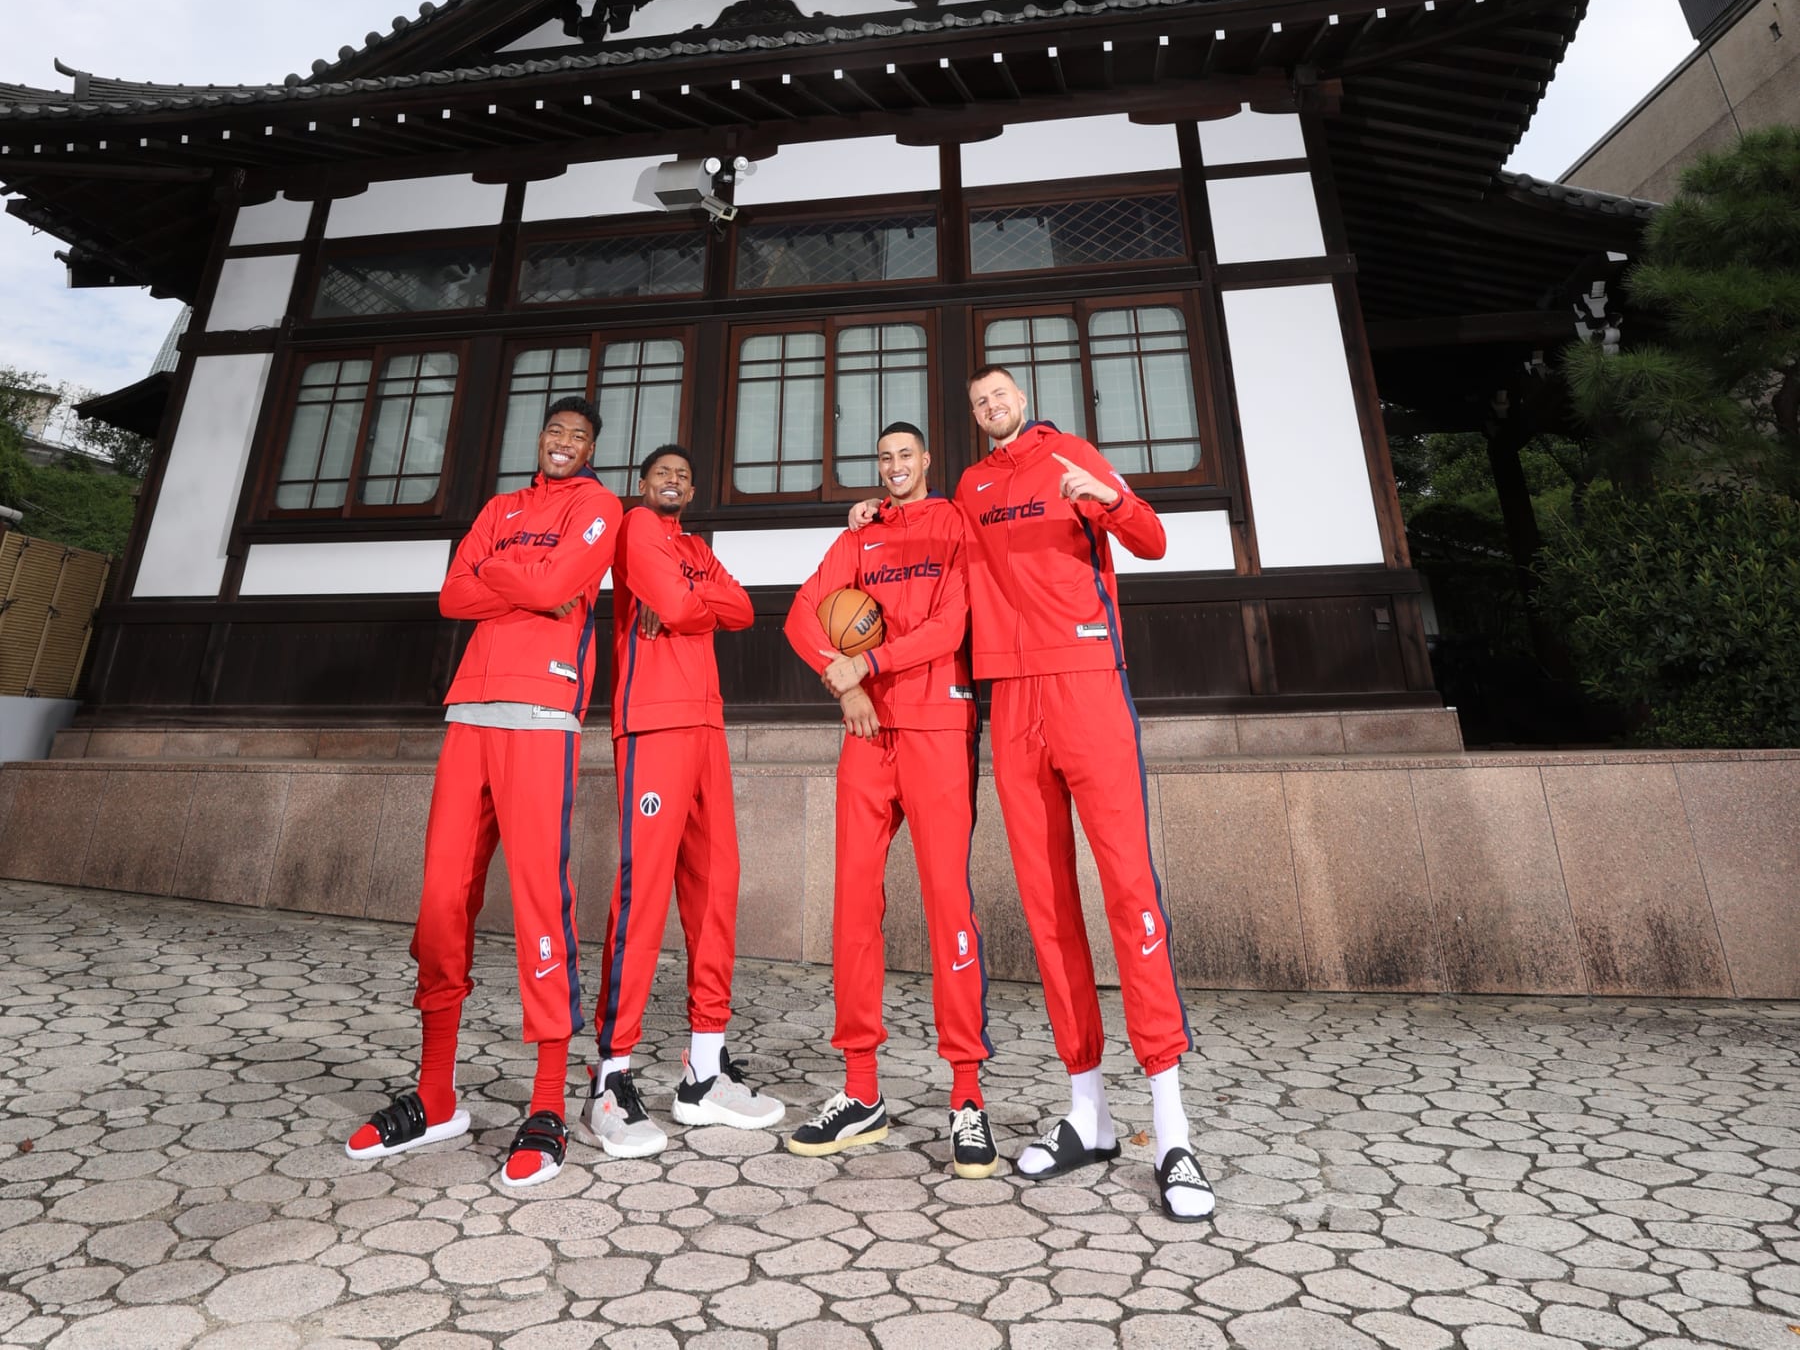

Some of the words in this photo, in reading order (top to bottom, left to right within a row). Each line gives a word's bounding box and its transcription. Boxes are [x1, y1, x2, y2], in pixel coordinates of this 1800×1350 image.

[979, 496, 1046, 526] wizards
[495, 527, 560, 551] wards
[863, 555, 942, 586] wizards
[1167, 1173, 1210, 1188] adidas
